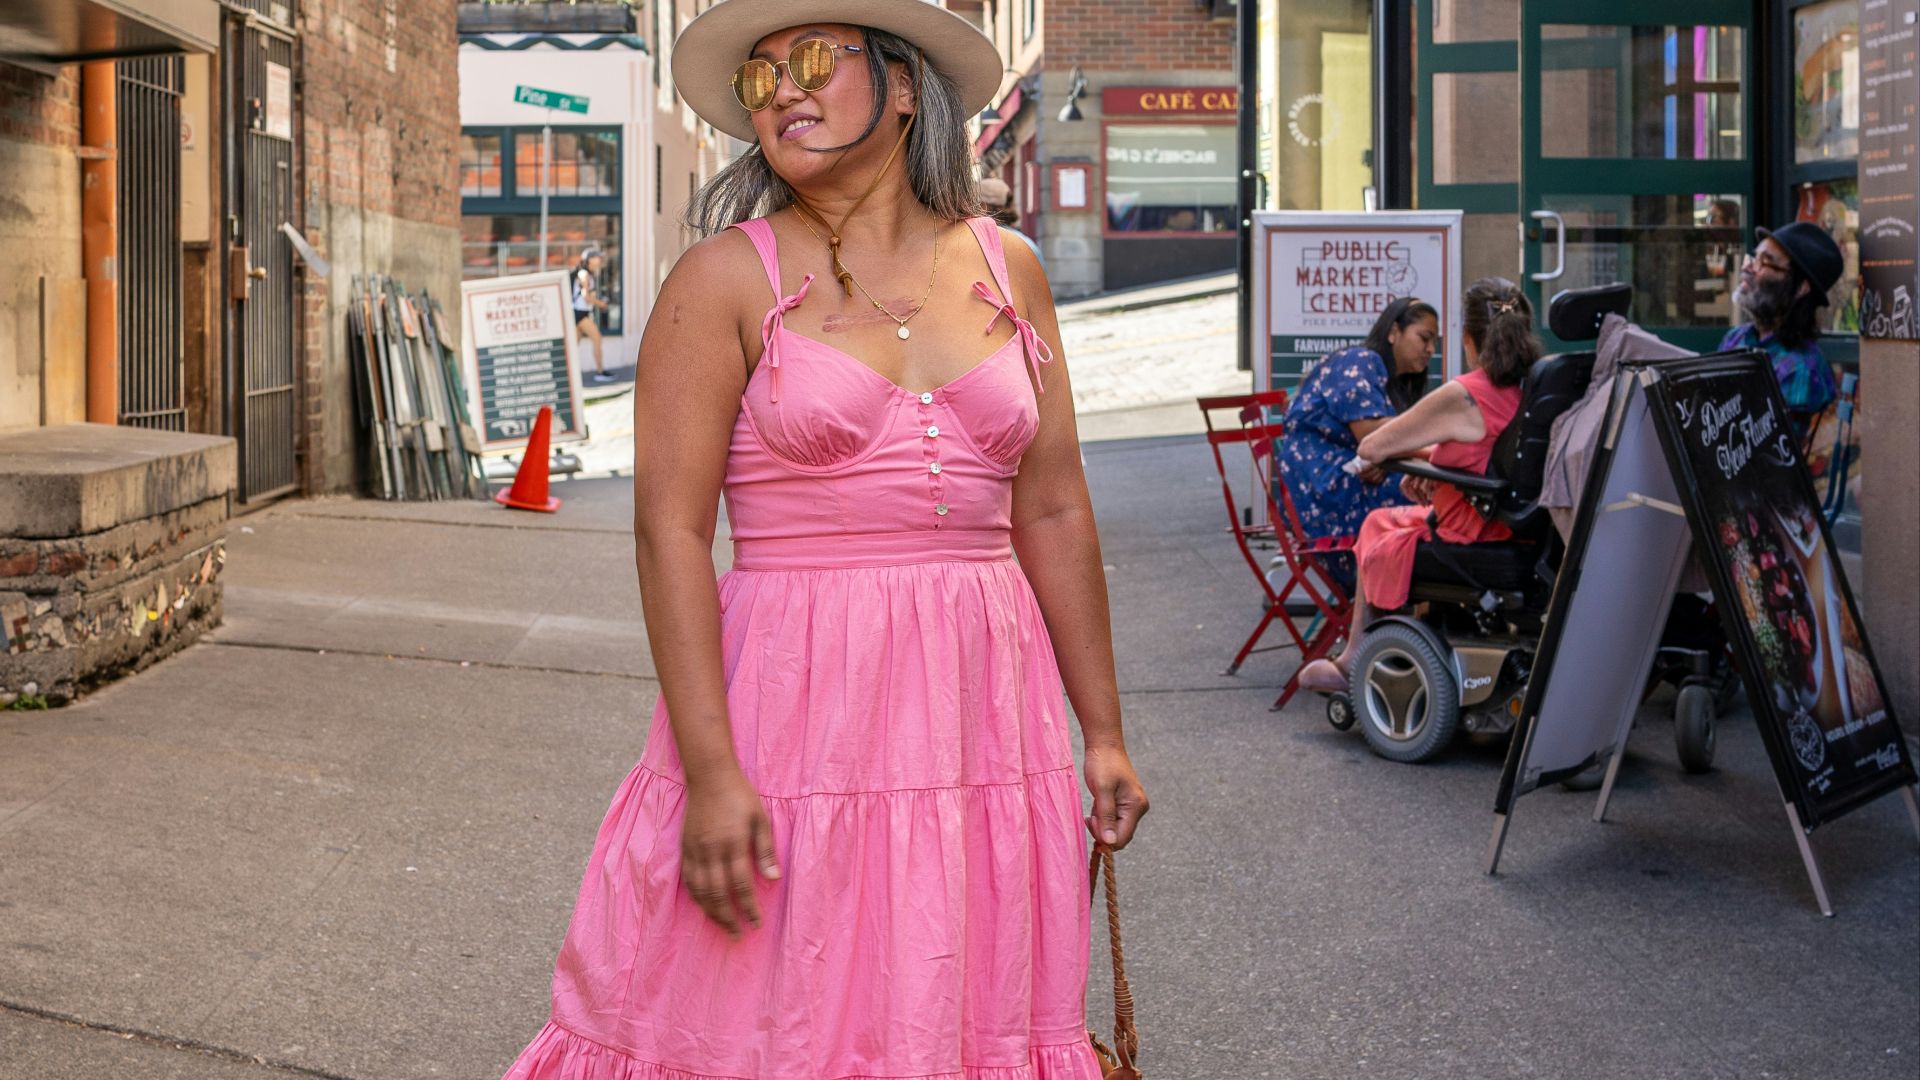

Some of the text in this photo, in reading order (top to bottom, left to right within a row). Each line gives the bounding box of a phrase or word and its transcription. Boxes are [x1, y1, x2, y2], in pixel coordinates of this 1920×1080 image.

[519, 86, 548, 105] Pine
[1140, 91, 1196, 110] CAFÉ
[1322, 241, 1400, 261] PUBLIC
[1296, 266, 1384, 287] MARKET
[486, 307, 530, 321] MARKET
[1303, 317, 1327, 327] PIKE
[1330, 317, 1363, 327] PLACE
[494, 319, 541, 333] CENTER
[1464, 676, 1491, 689] C300
